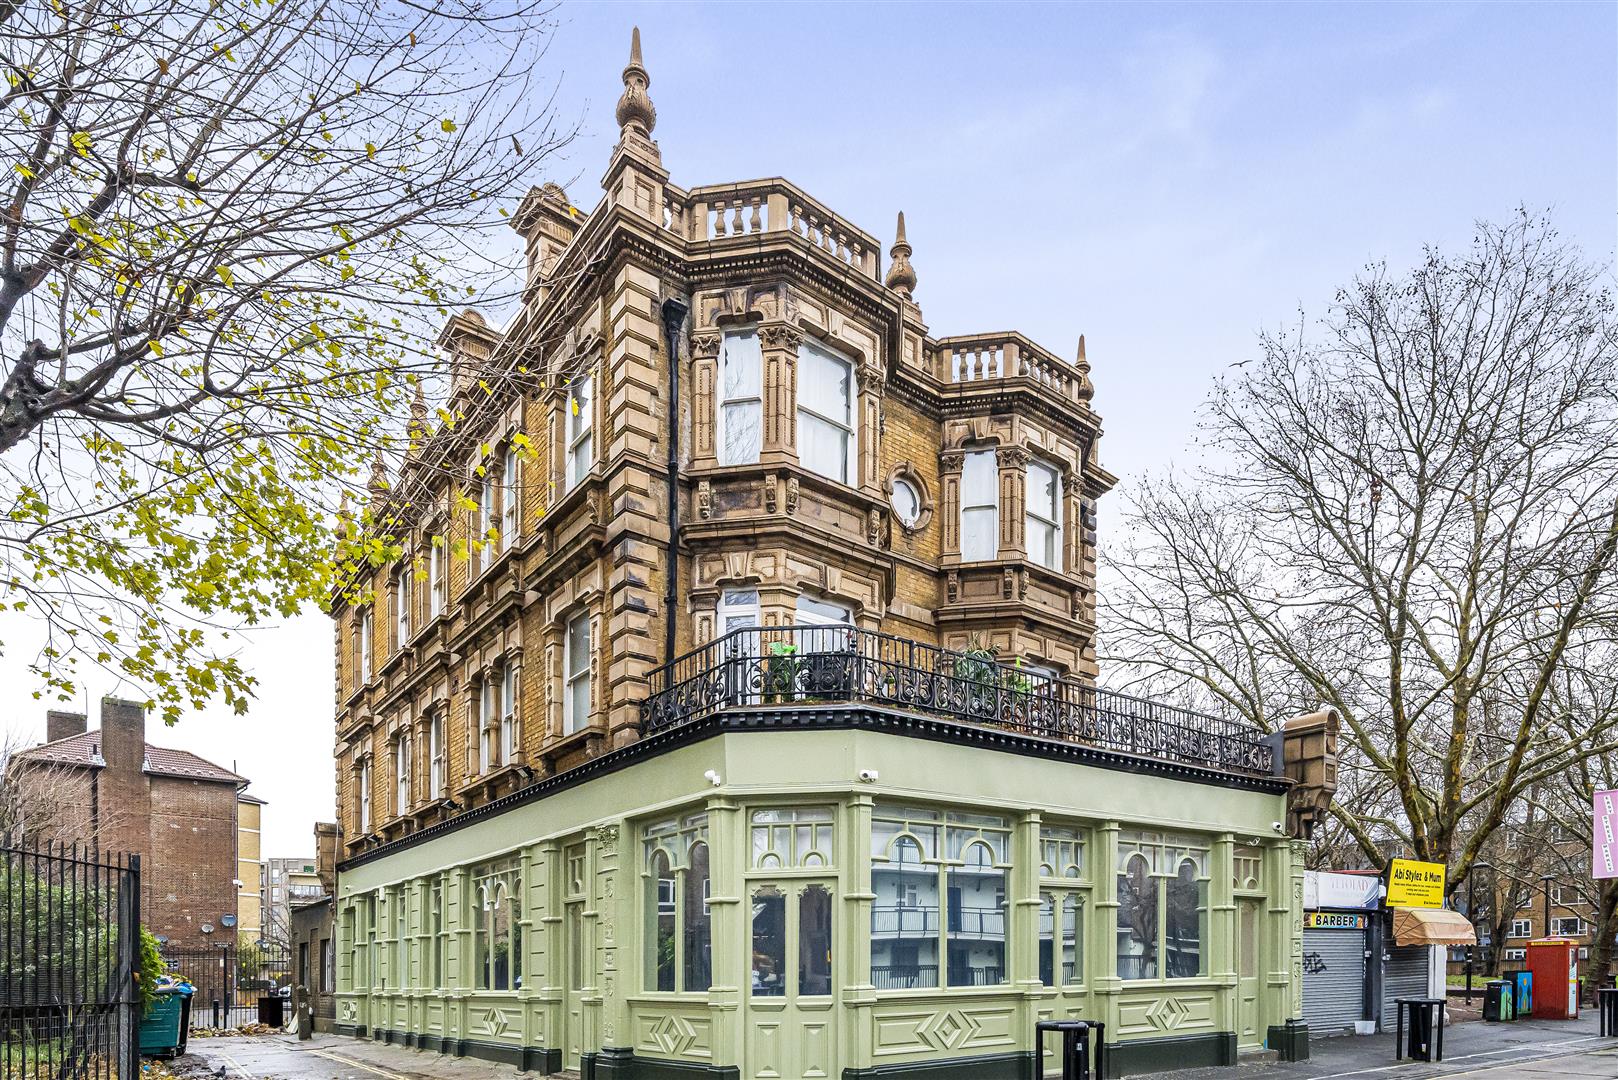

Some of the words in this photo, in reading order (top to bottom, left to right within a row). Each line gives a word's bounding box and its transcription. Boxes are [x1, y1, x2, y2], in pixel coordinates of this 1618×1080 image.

[1394, 868, 1404, 879] Abi
[1405, 870, 1422, 882] Stylez
[1429, 872, 1441, 882] Mum
[1315, 915, 1354, 926] BARBER
